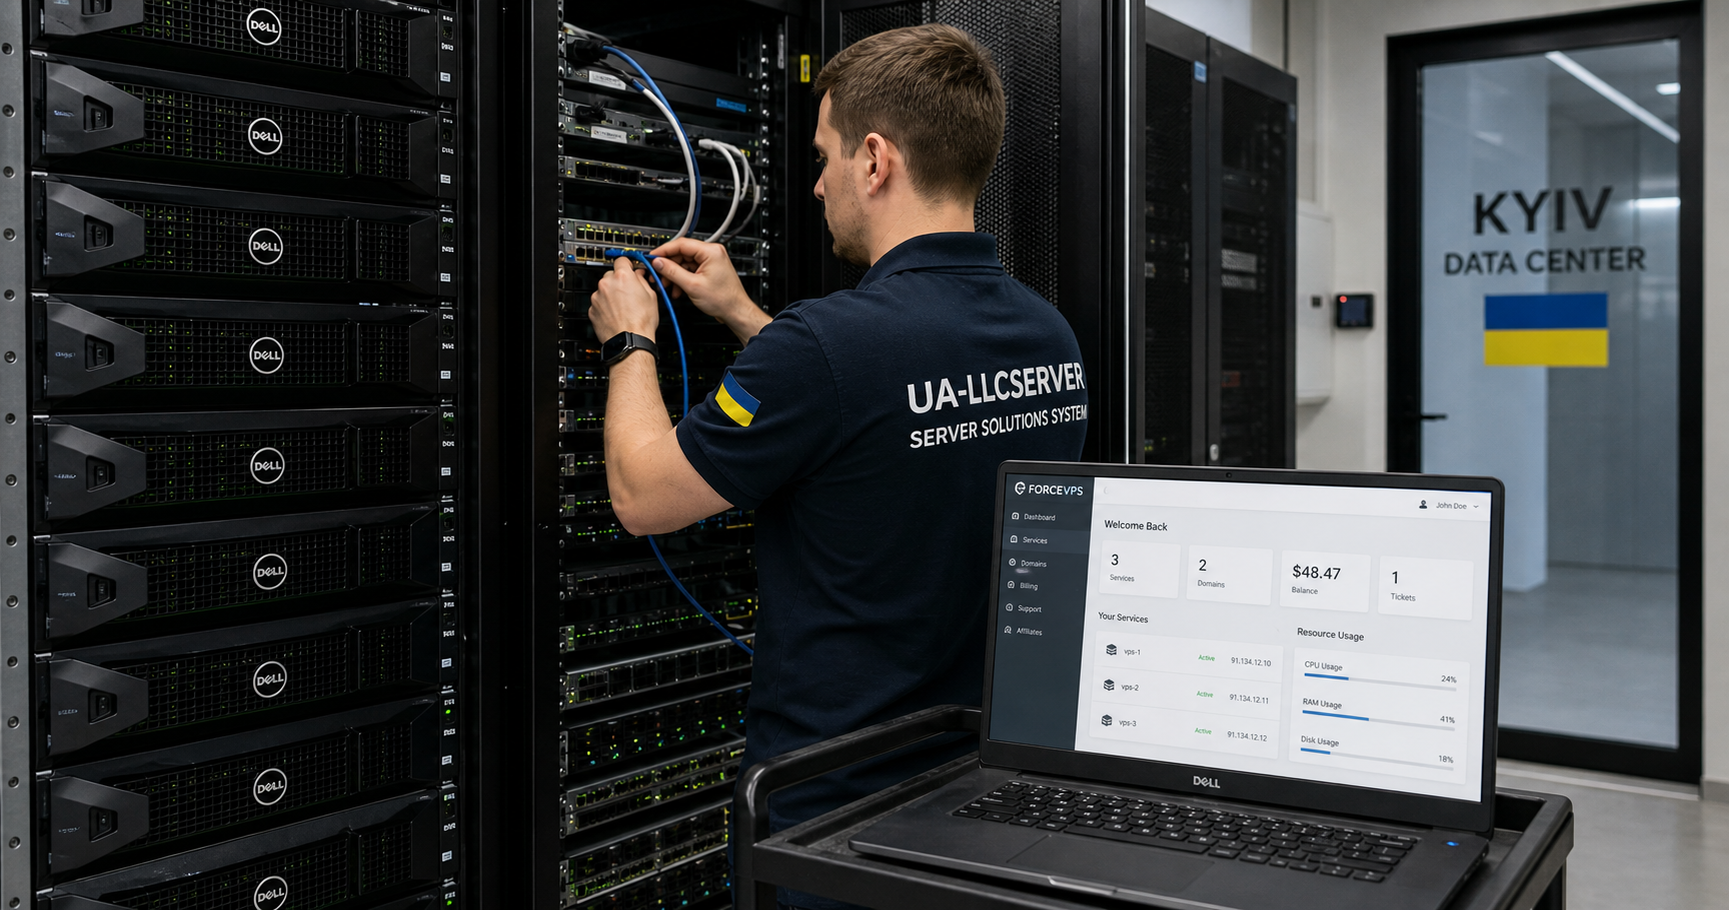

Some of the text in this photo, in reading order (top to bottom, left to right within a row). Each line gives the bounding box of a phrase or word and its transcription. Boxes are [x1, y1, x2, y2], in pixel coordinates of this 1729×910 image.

[251, 20, 278, 34] DELL
[252, 130, 279, 143] DELL
[1474, 185, 1614, 235] KYIV
[253, 241, 280, 253] DELL
[1444, 246, 1647, 276] DATA CENTER
[254, 350, 281, 360] DELL
[907, 362, 1085, 414] UA-LLCSERVER
[910, 422, 977, 448] SERVER
[982, 410, 1048, 436] SOLUTIONS
[254, 461, 281, 472] DELL
[1028, 484, 1084, 496] FORCEVPS
[1435, 501, 1468, 510] John Doe
[1023, 513, 1056, 522] Dashboard
[1104, 519, 1168, 532] Welcome Back
[1022, 536, 1048, 545] Services
[1020, 559, 1047, 568] Domains
[1111, 553, 1119, 566] 3
[1198, 558, 1207, 572] 2
[257, 566, 284, 577] DELL
[1109, 573, 1135, 583] Services
[1292, 563, 1341, 580] $48.47
[1392, 570, 1398, 584] 1
[1019, 582, 1039, 592] Billing
[1197, 579, 1226, 589] Domains
[1291, 585, 1319, 595] Balance
[1390, 592, 1417, 602] Tickets
[1017, 604, 1042, 614] Support
[1098, 611, 1149, 624] Your Services
[1016, 627, 1043, 636] Affiliates
[1297, 627, 1365, 643] Resource Usage
[1197, 654, 1216, 662] Active
[1230, 656, 1272, 667] 91.134.12.10
[1304, 660, 1343, 673] CPU Usage
[257, 673, 284, 686] DELL
[1441, 674, 1458, 684] 24%
[1120, 684, 1269, 705] vps-2 Active 91.134.12.11
[1302, 697, 1343, 711] RAM Usage
[1439, 715, 1456, 724] 41%
[1118, 720, 1268, 742] vps-3 Active 91.134.12.12
[1300, 735, 1340, 749] Disk Usage
[1438, 754, 1454, 764] 18%
[257, 781, 284, 794] DELL
[1193, 775, 1221, 789] DELL
[257, 888, 284, 902] DELL
